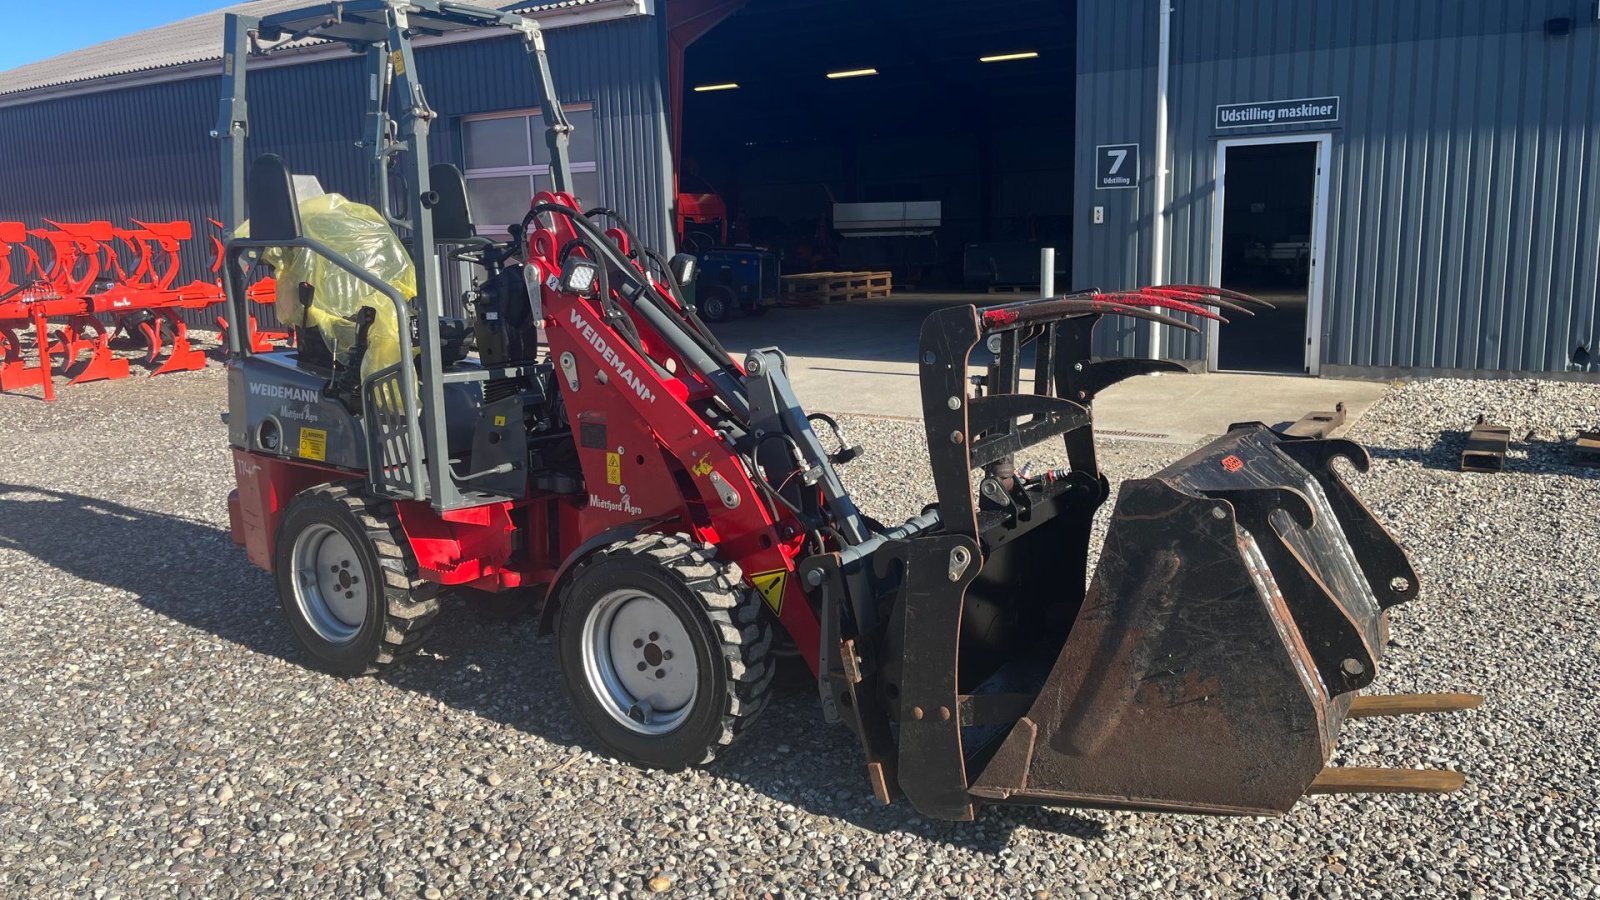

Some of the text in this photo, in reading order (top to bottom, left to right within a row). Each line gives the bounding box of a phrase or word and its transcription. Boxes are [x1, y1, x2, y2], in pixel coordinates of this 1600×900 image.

[1221, 103, 1333, 122] Udstilling maskiner
[1107, 149, 1127, 175] 7
[1103, 176, 1130, 185] Udstilling
[570, 308, 656, 403] WEIDEMANN
[249, 382, 318, 403] WEIDEMANN
[589, 494, 642, 516] Midtfjord Agro
